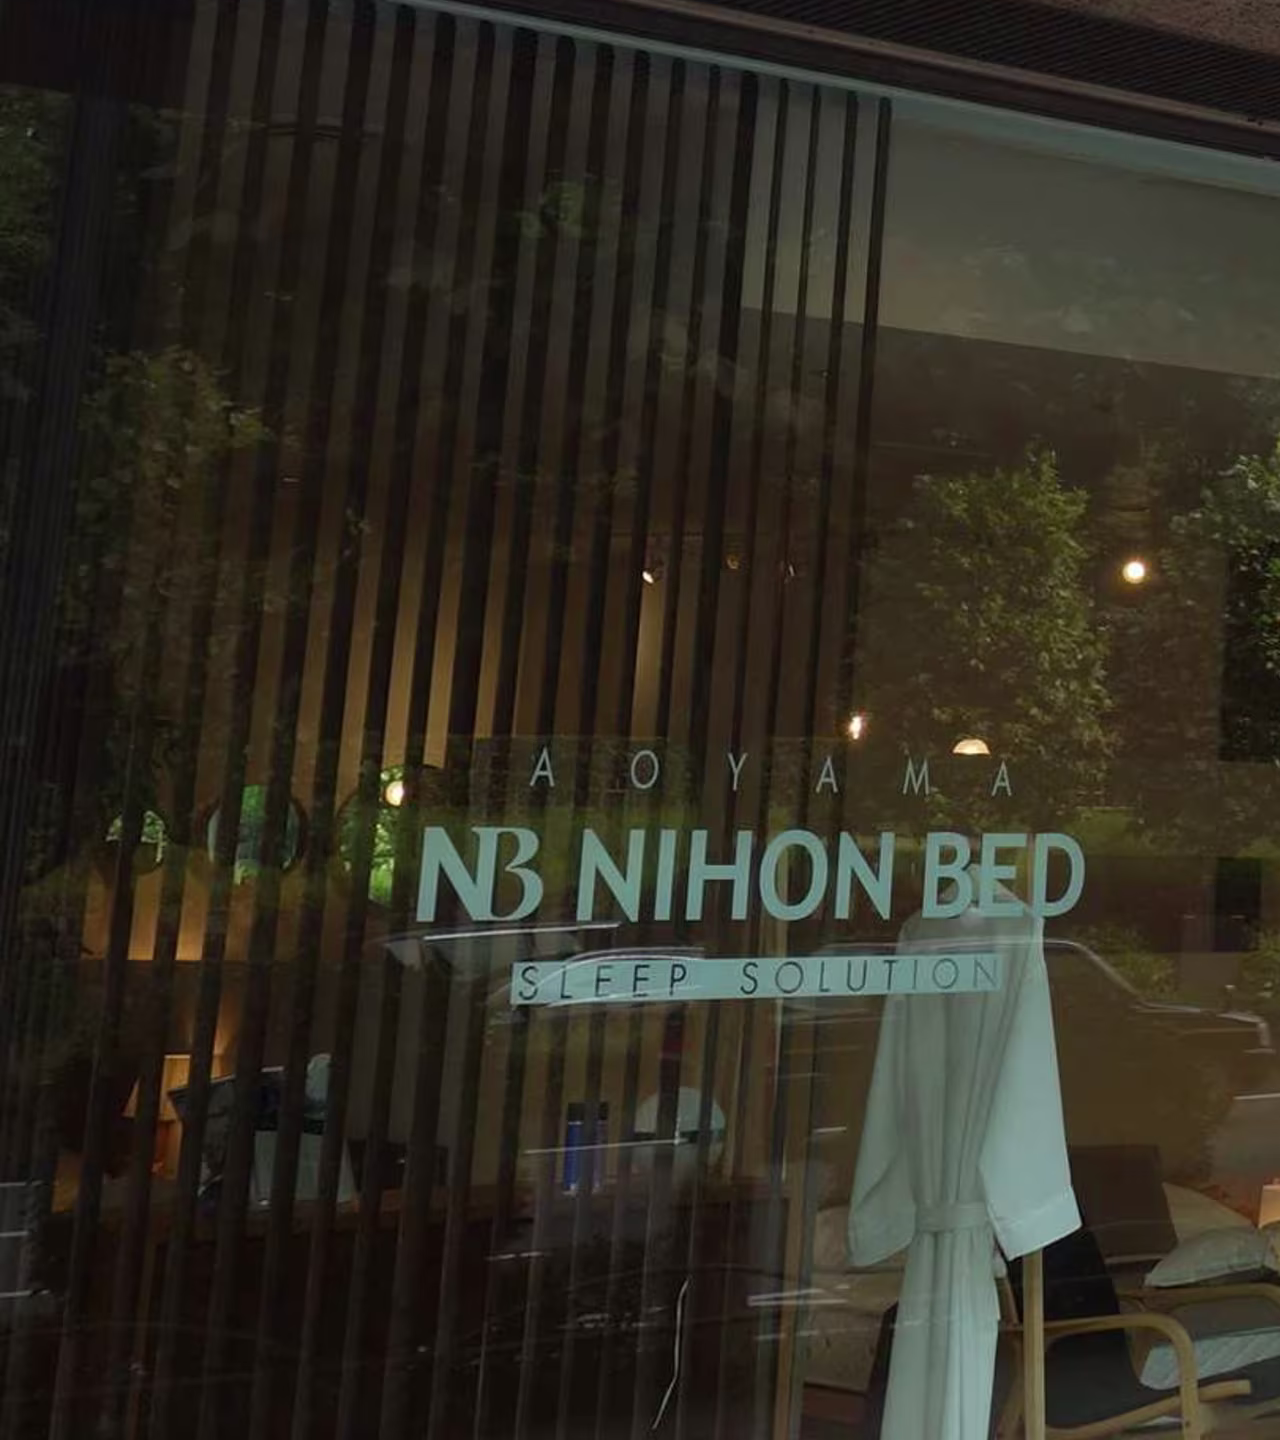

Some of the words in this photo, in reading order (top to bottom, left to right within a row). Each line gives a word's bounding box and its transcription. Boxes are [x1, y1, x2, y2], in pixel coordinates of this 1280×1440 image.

[529, 746, 1012, 797] AOYAMA
[575, 828, 895, 923] NIHON
[922, 831, 1087, 921] BED
[518, 960, 691, 1002] SLEEP
[740, 955, 1000, 996] SOLUTION
